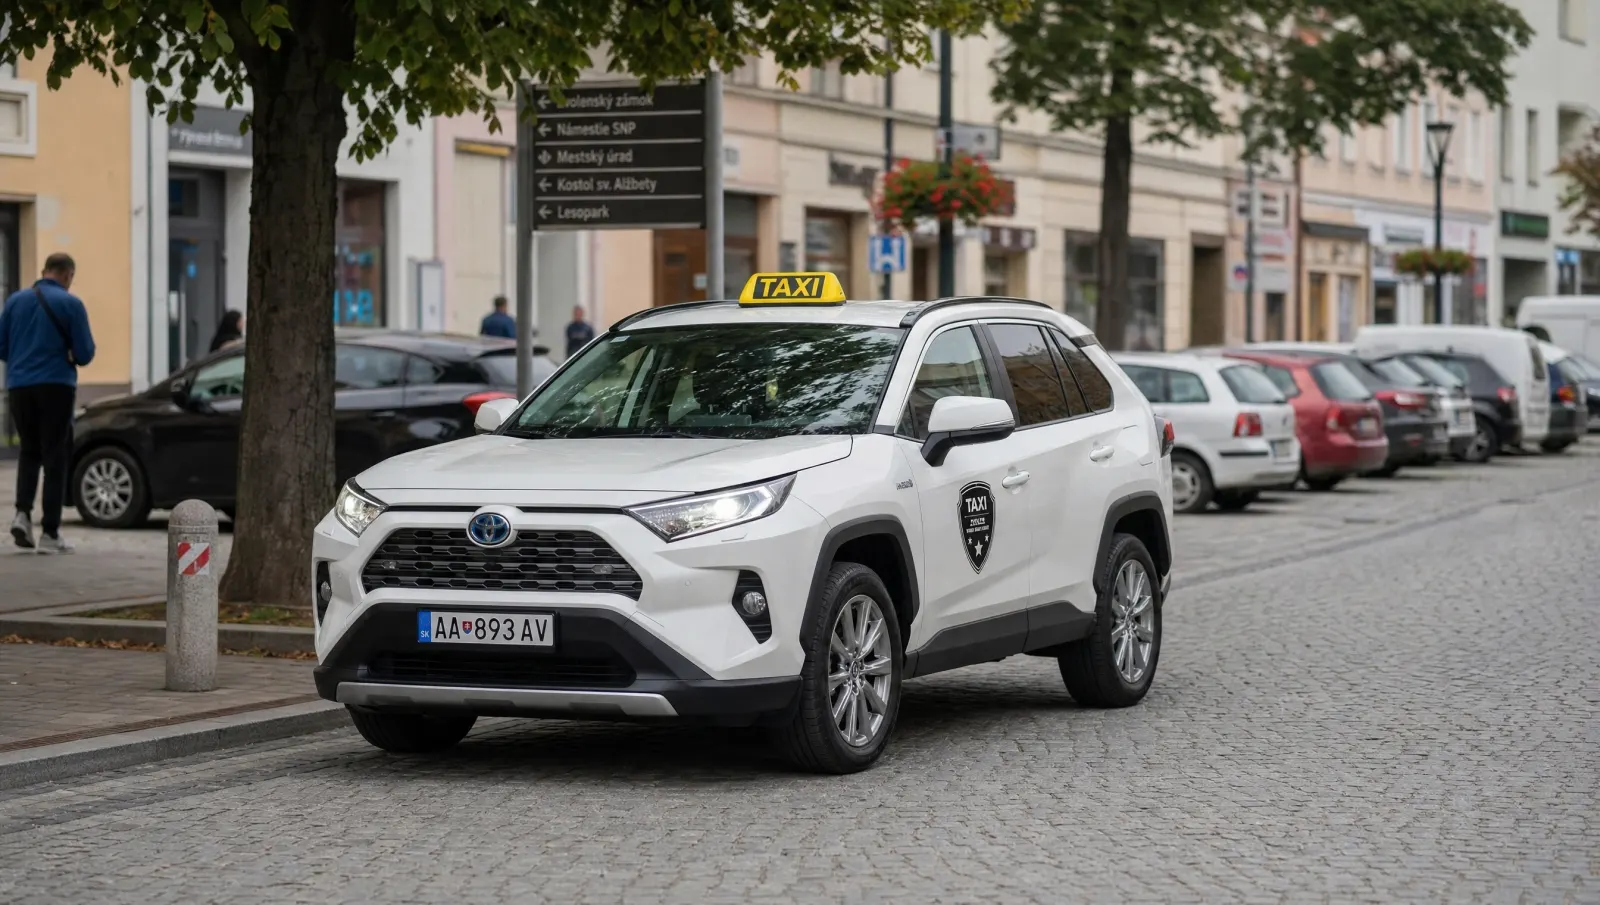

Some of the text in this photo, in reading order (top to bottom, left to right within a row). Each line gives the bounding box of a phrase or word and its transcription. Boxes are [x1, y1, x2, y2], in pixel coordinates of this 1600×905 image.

[556, 93, 613, 110] volenský
[556, 121, 637, 136] Námestie SNP
[556, 148, 634, 166] Mestský úrad
[556, 177, 594, 191] Kostol
[596, 180, 613, 191] sv.
[556, 204, 610, 221] Lesopark
[760, 277, 821, 297] TAXI
[965, 495, 988, 513] TAXI
[420, 630, 430, 638] SK
[434, 616, 548, 642] AA 893 AV
